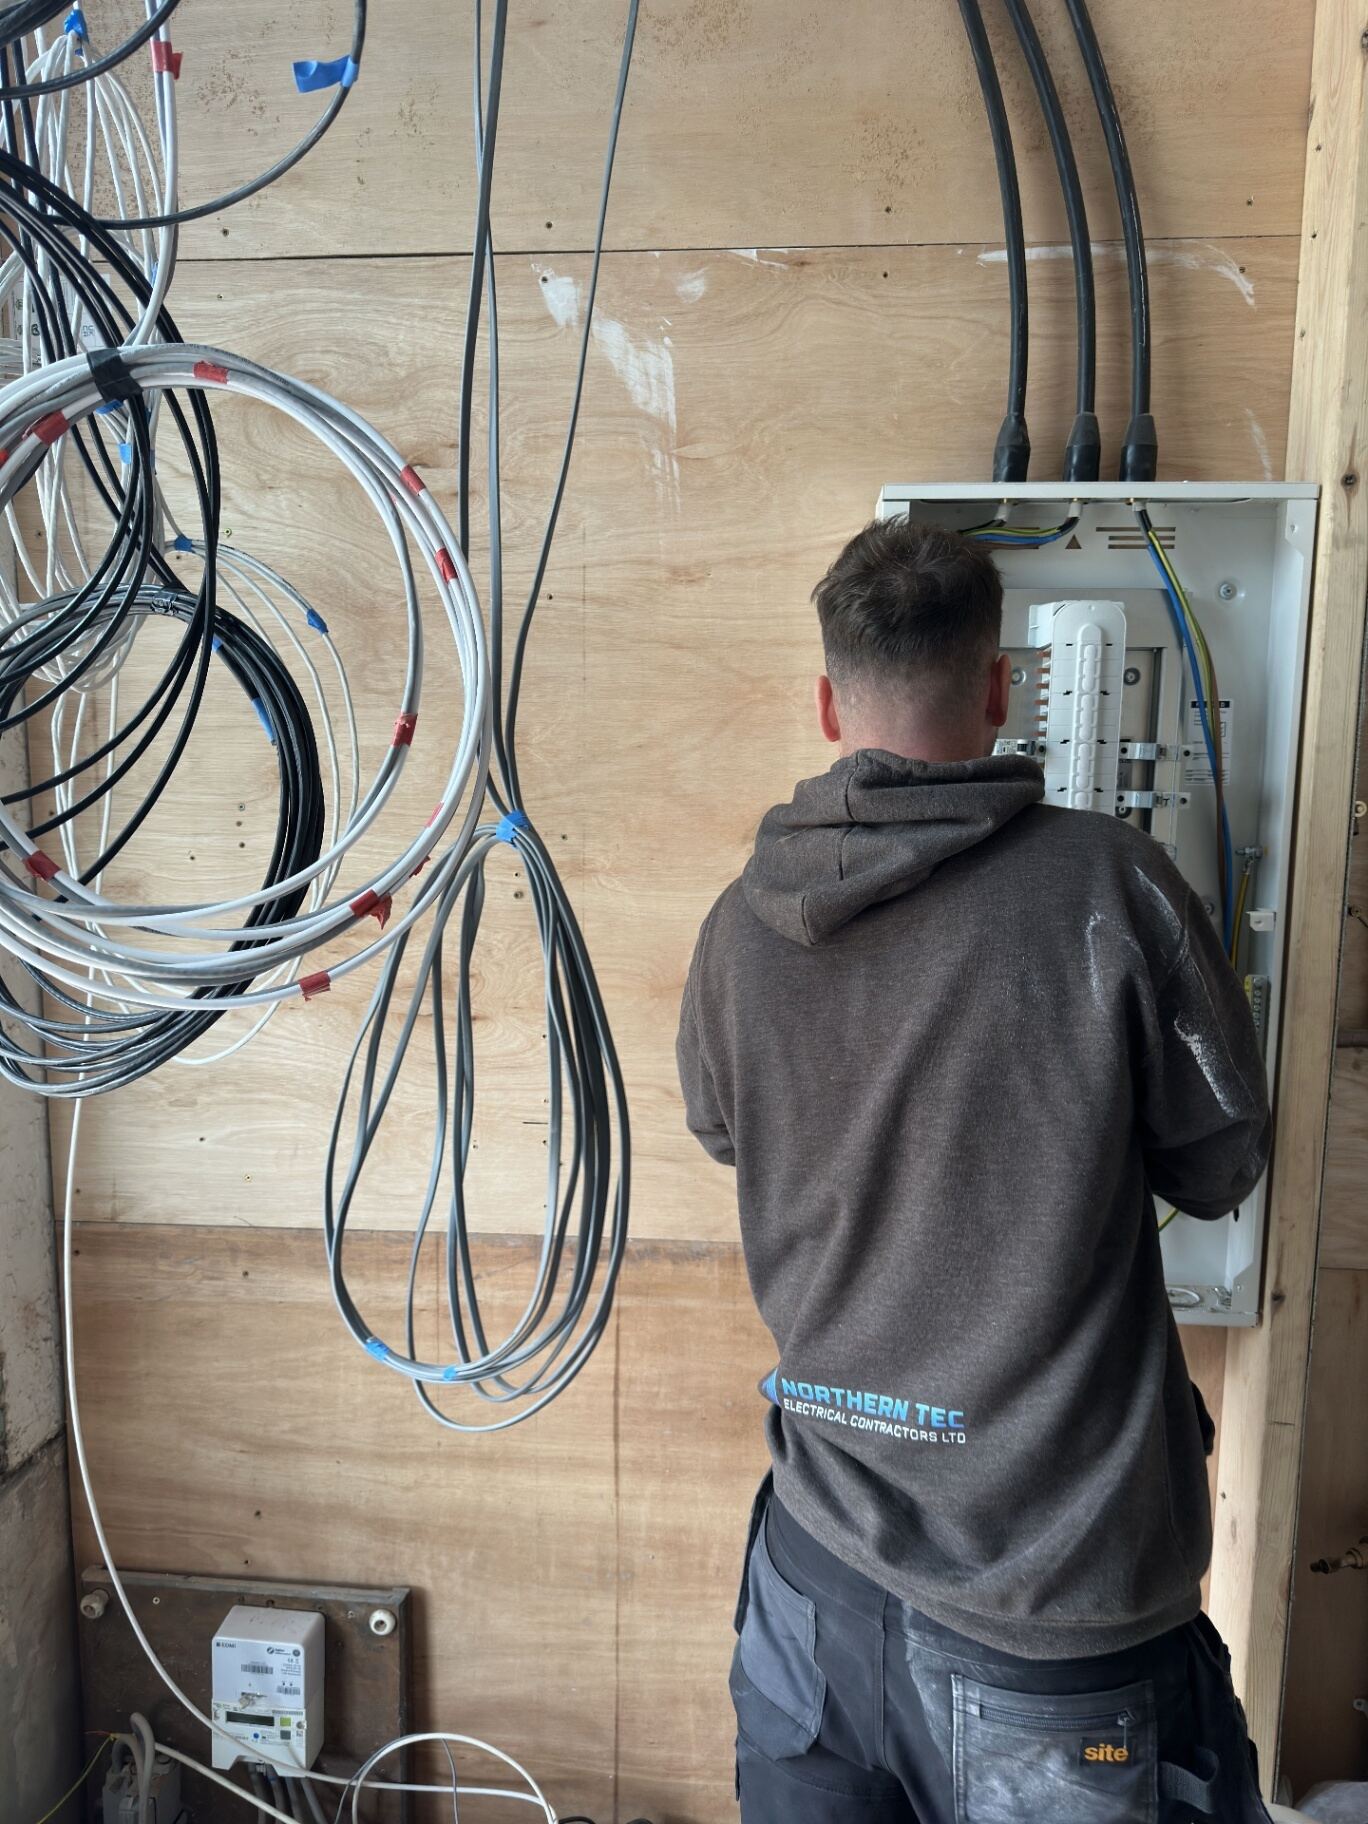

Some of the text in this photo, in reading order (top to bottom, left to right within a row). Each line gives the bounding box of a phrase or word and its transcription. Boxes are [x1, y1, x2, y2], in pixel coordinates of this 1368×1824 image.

[781, 1377, 965, 1429] NORTHERN TEC
[783, 1398, 966, 1444] ELECTRICAL CONTRACTORS LTD
[1084, 1743, 1129, 1762] site
